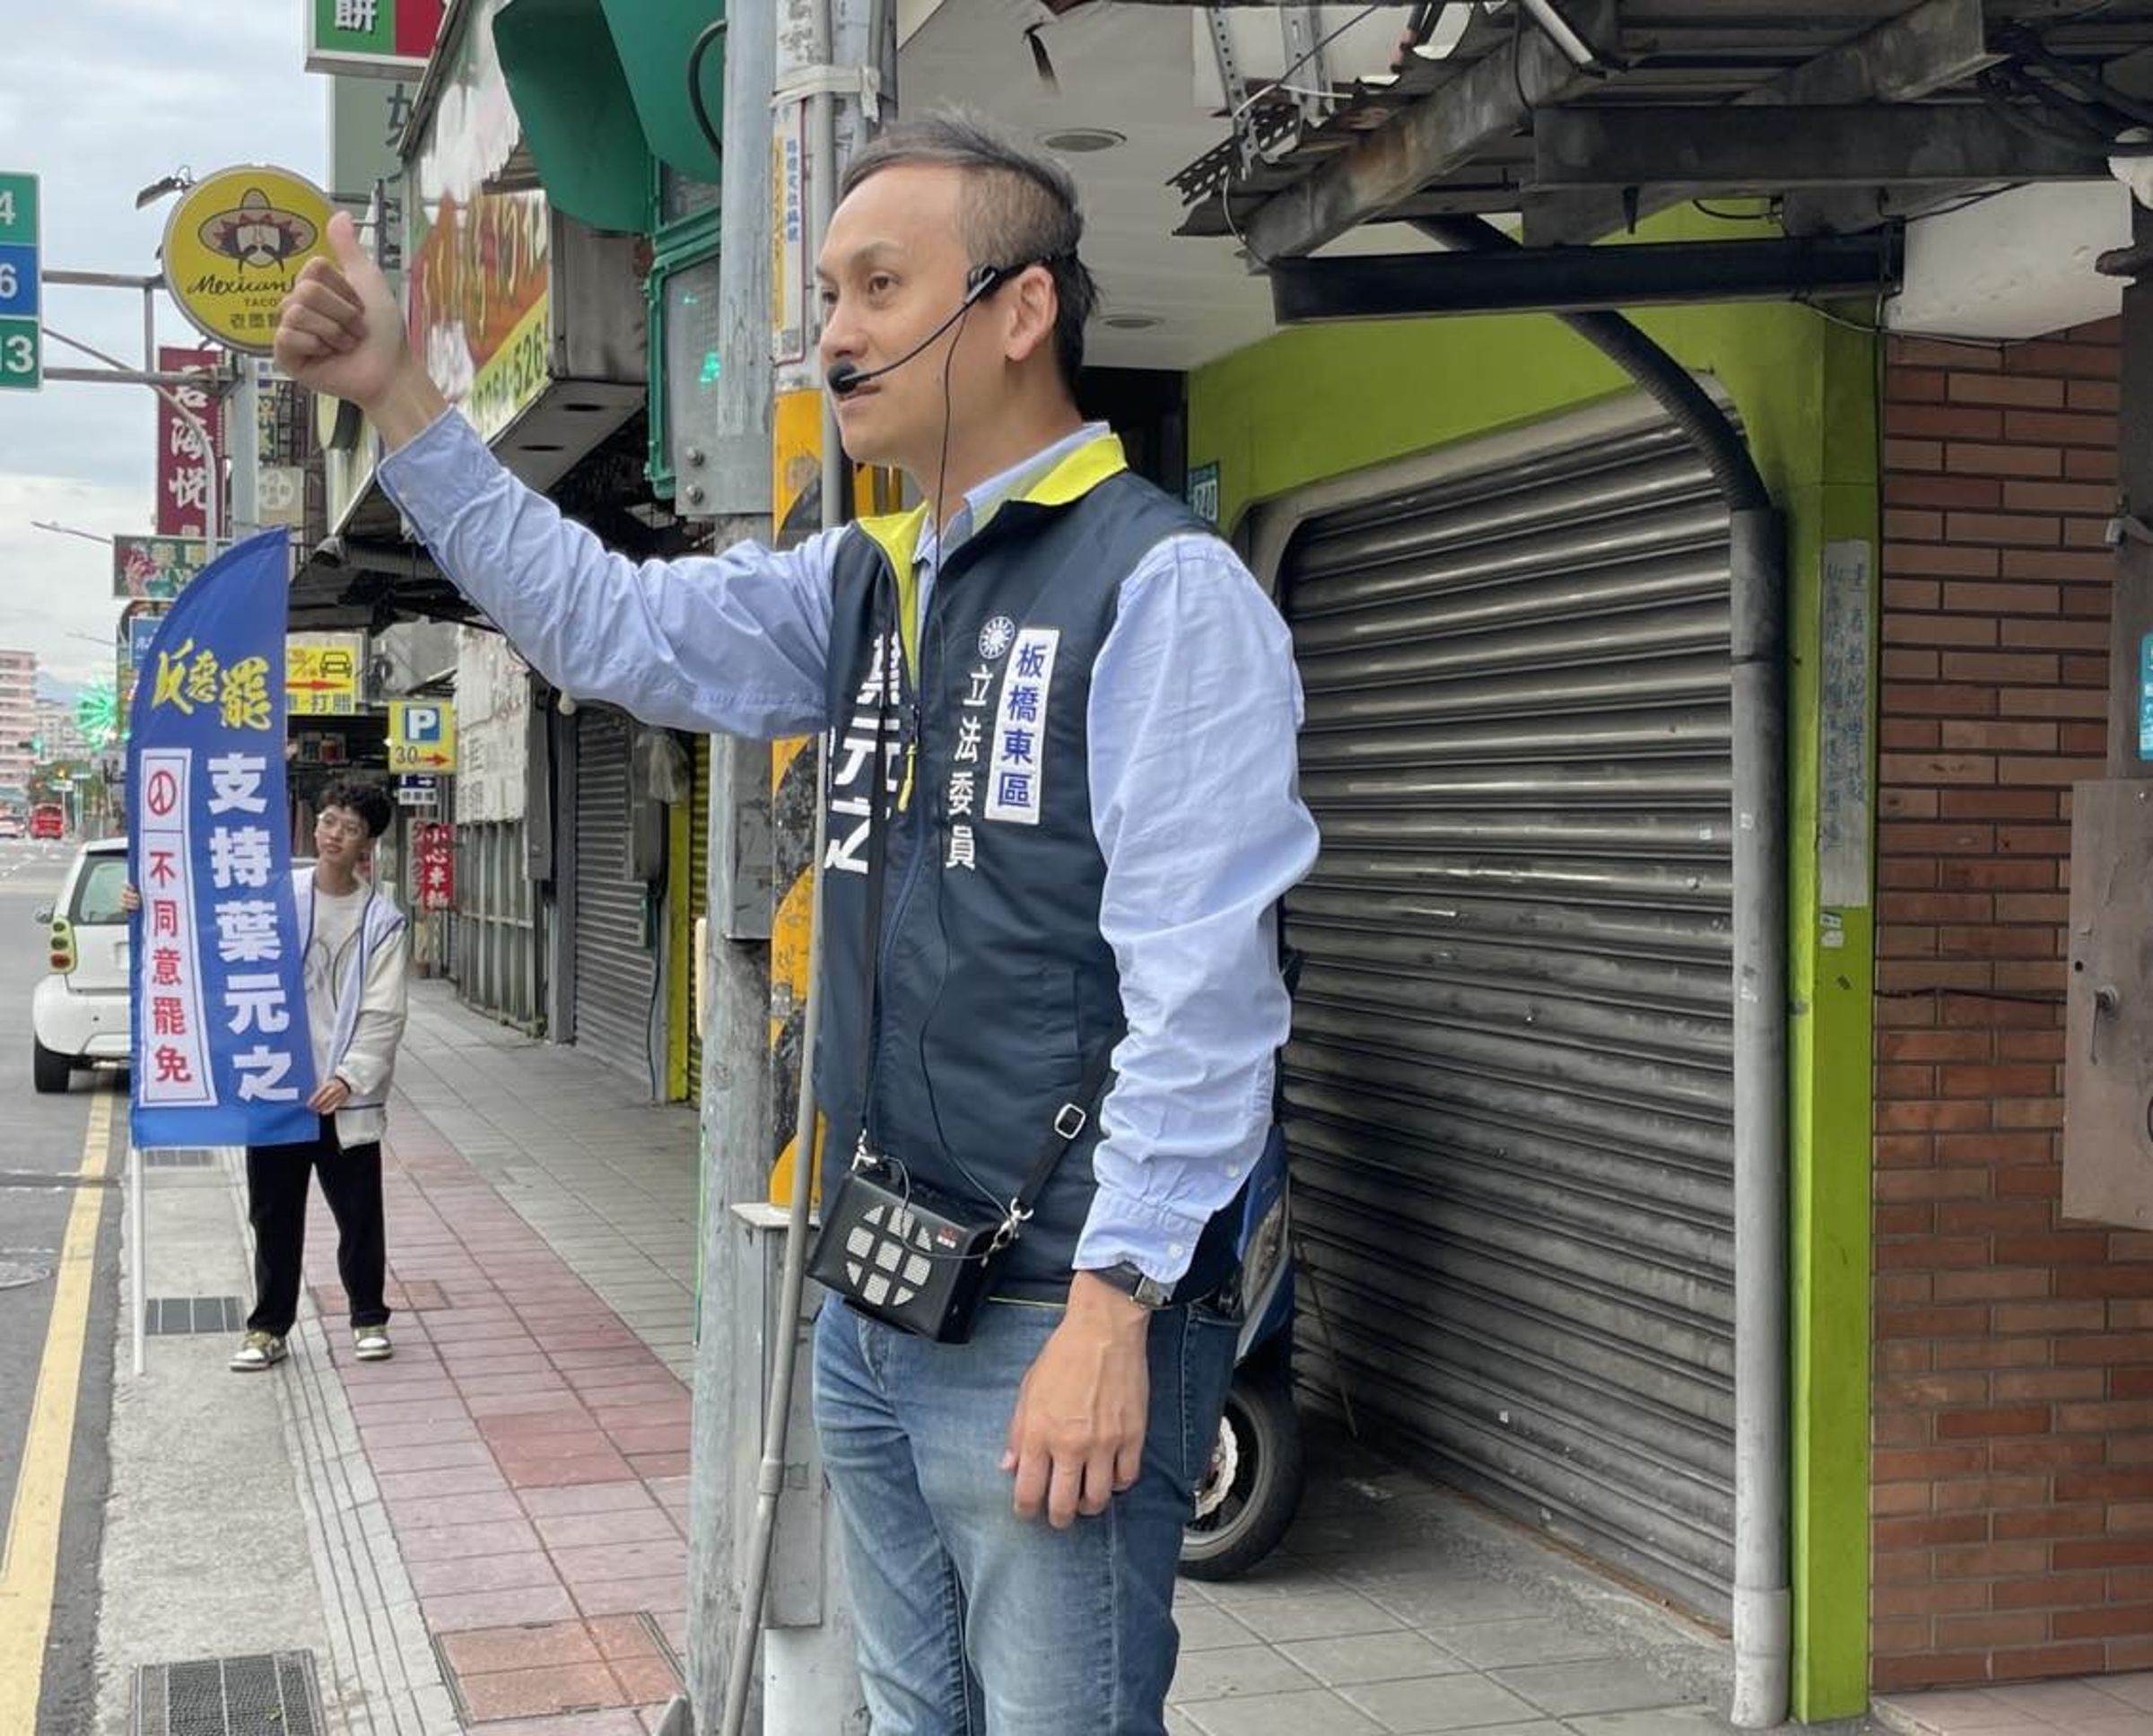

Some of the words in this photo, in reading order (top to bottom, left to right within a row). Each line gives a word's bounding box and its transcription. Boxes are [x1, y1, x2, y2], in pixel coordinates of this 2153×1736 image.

[0, 335, 34, 373] 3
[408, 709, 437, 740] P
[946, 665, 994, 870] 立法委員
[998, 642, 1047, 809] 板橋東區
[148, 851, 192, 1084] 不同意罷免
[208, 754, 299, 1103] 支持葉元之
